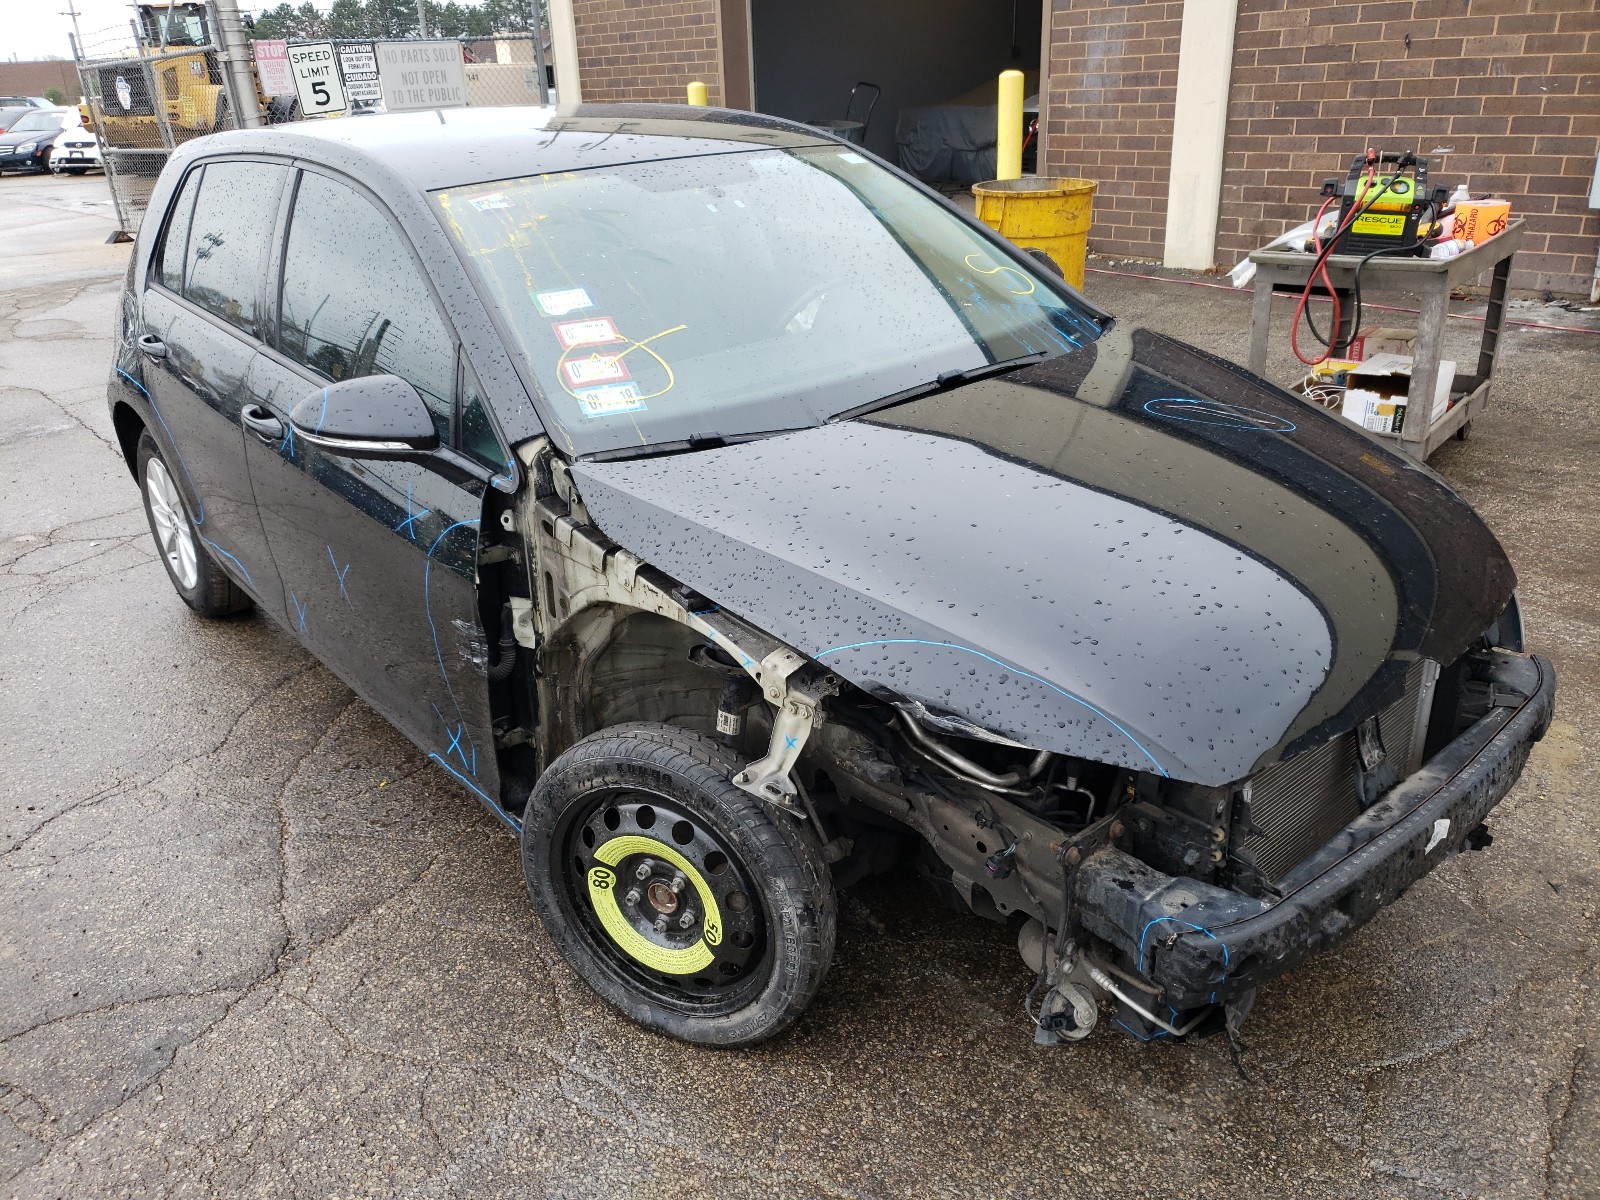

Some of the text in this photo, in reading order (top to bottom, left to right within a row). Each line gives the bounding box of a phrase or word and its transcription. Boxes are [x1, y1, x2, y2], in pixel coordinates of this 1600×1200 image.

[257, 45, 285, 58] STOP
[292, 50, 331, 64] SPEED
[340, 44, 372, 54] CAUTION
[384, 48, 457, 64] NO PARTS SOLD
[300, 66, 330, 78] LIMIT
[345, 72, 377, 81] CUIDADO
[401, 70, 448, 86] NOT OPEN
[311, 81, 331, 106] 5
[392, 87, 462, 104] TO THE PUBLIC
[1357, 216, 1403, 225] RESCUE
[1465, 208, 1479, 242] OHAZARD
[593, 869, 611, 890] 80
[706, 919, 719, 944] 50
